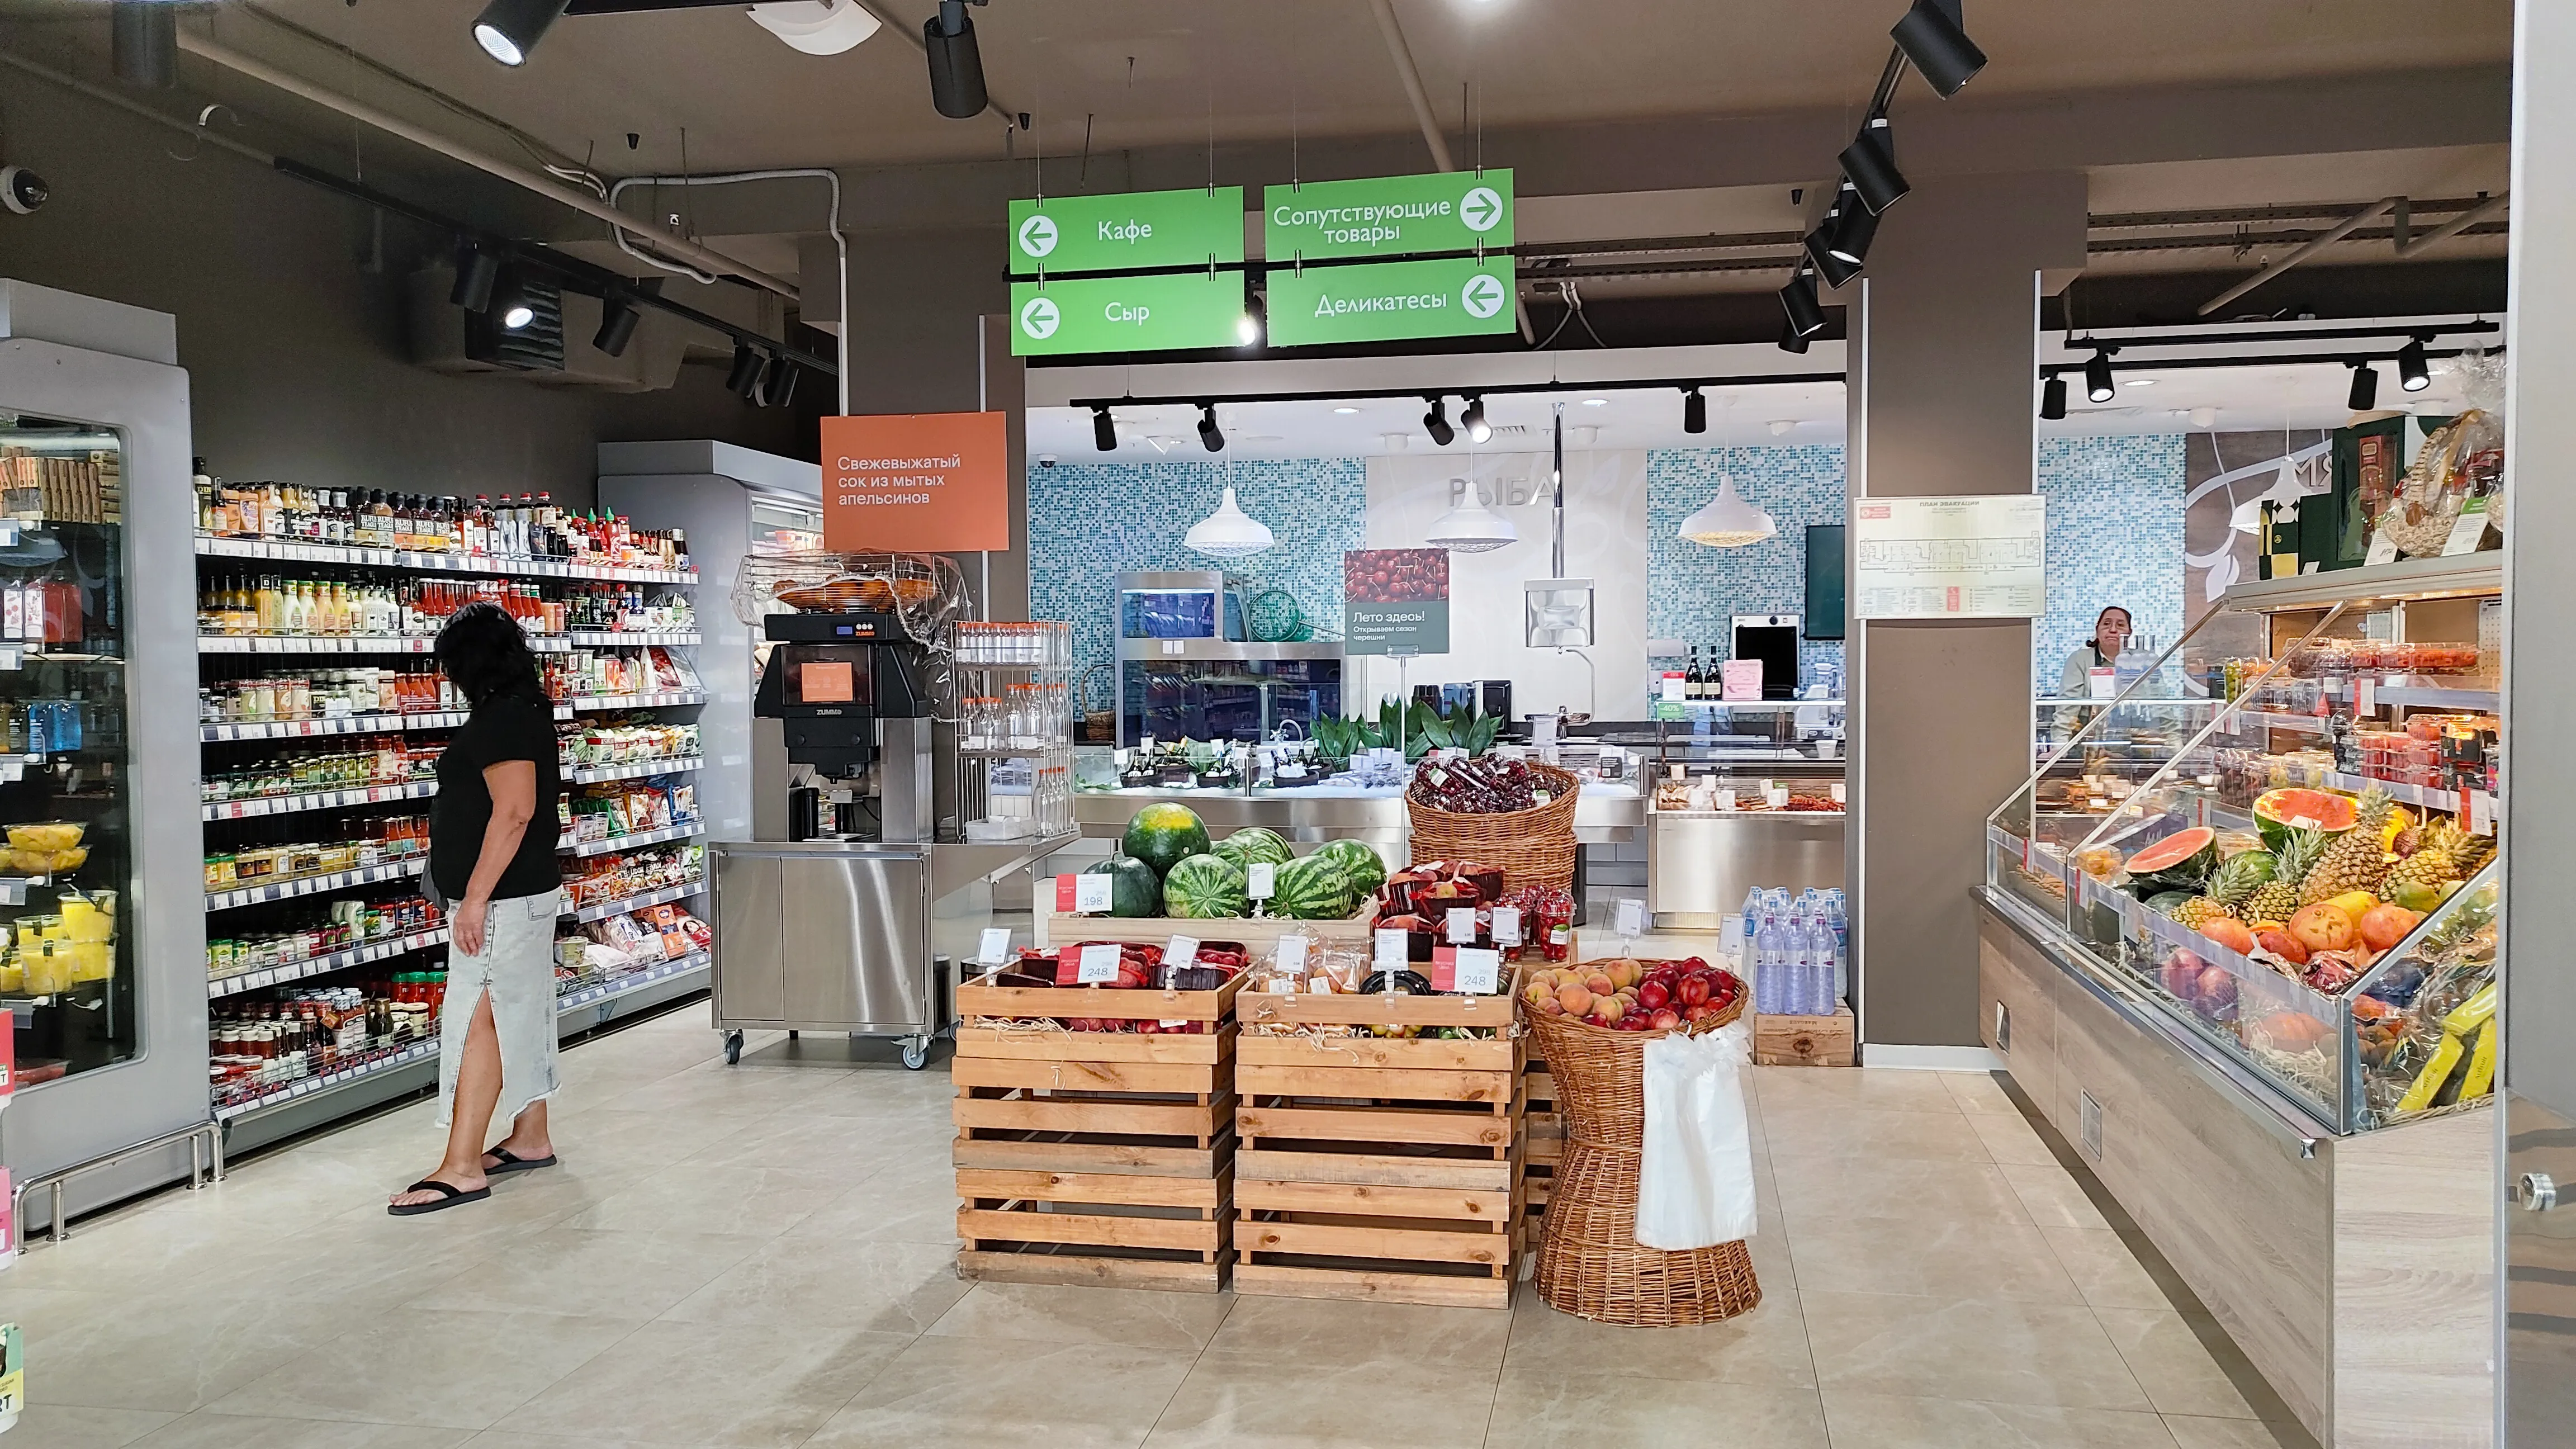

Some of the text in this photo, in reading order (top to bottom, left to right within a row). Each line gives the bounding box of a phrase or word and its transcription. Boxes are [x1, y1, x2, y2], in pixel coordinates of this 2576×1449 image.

[1274, 199, 1451, 230] Сопутствующие
[1098, 219, 1152, 245] Кафе
[1324, 224, 1401, 247] товары
[1314, 291, 1448, 318] Деликатесы
[1105, 302, 1150, 326] Сыр
[837, 453, 961, 471] Свежевыжатый
[838, 475, 945, 488] сок из мытых
[1449, 476, 1555, 506] РЫБА
[838, 493, 930, 506] апельсинов
[1353, 610, 1426, 624] Лето здесь!
[1353, 626, 1394, 634] Открываем
[1084, 897, 1102, 906] 198
[1087, 968, 1108, 977] 248
[1464, 975, 1486, 986] 248
